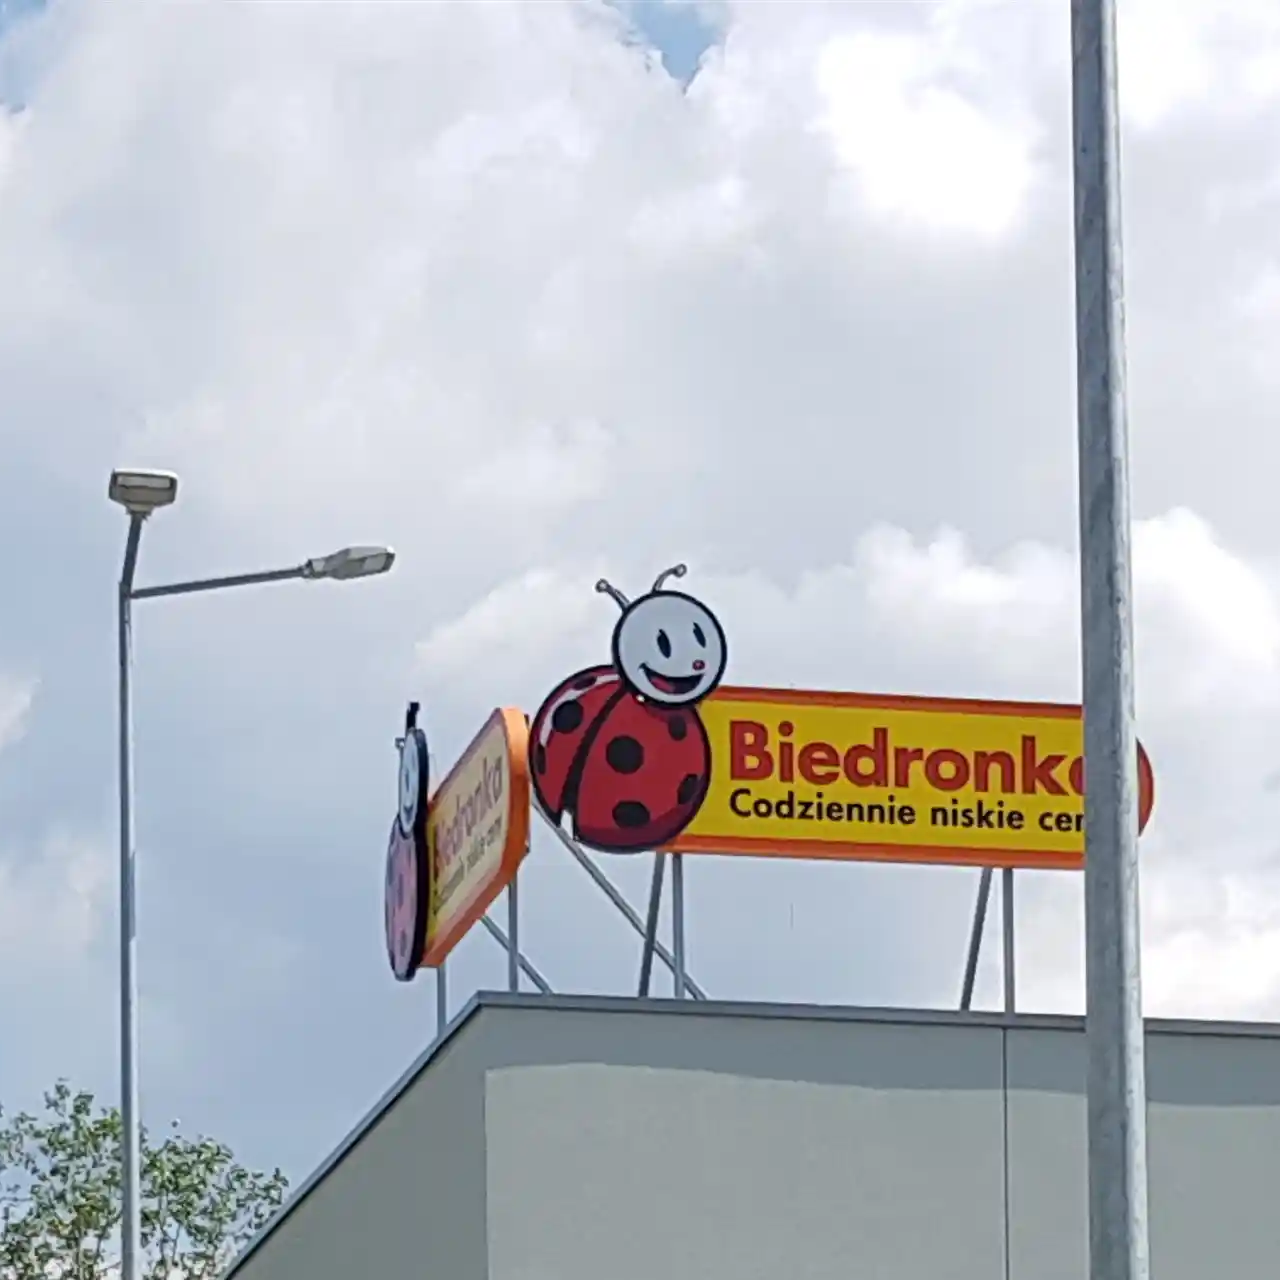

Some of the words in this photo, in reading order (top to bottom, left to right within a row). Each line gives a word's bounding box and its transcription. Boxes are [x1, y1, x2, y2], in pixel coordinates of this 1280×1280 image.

[729, 788, 916, 826] Codziennie
[930, 798, 1025, 831] niskie
[1038, 810, 1085, 832] ce
